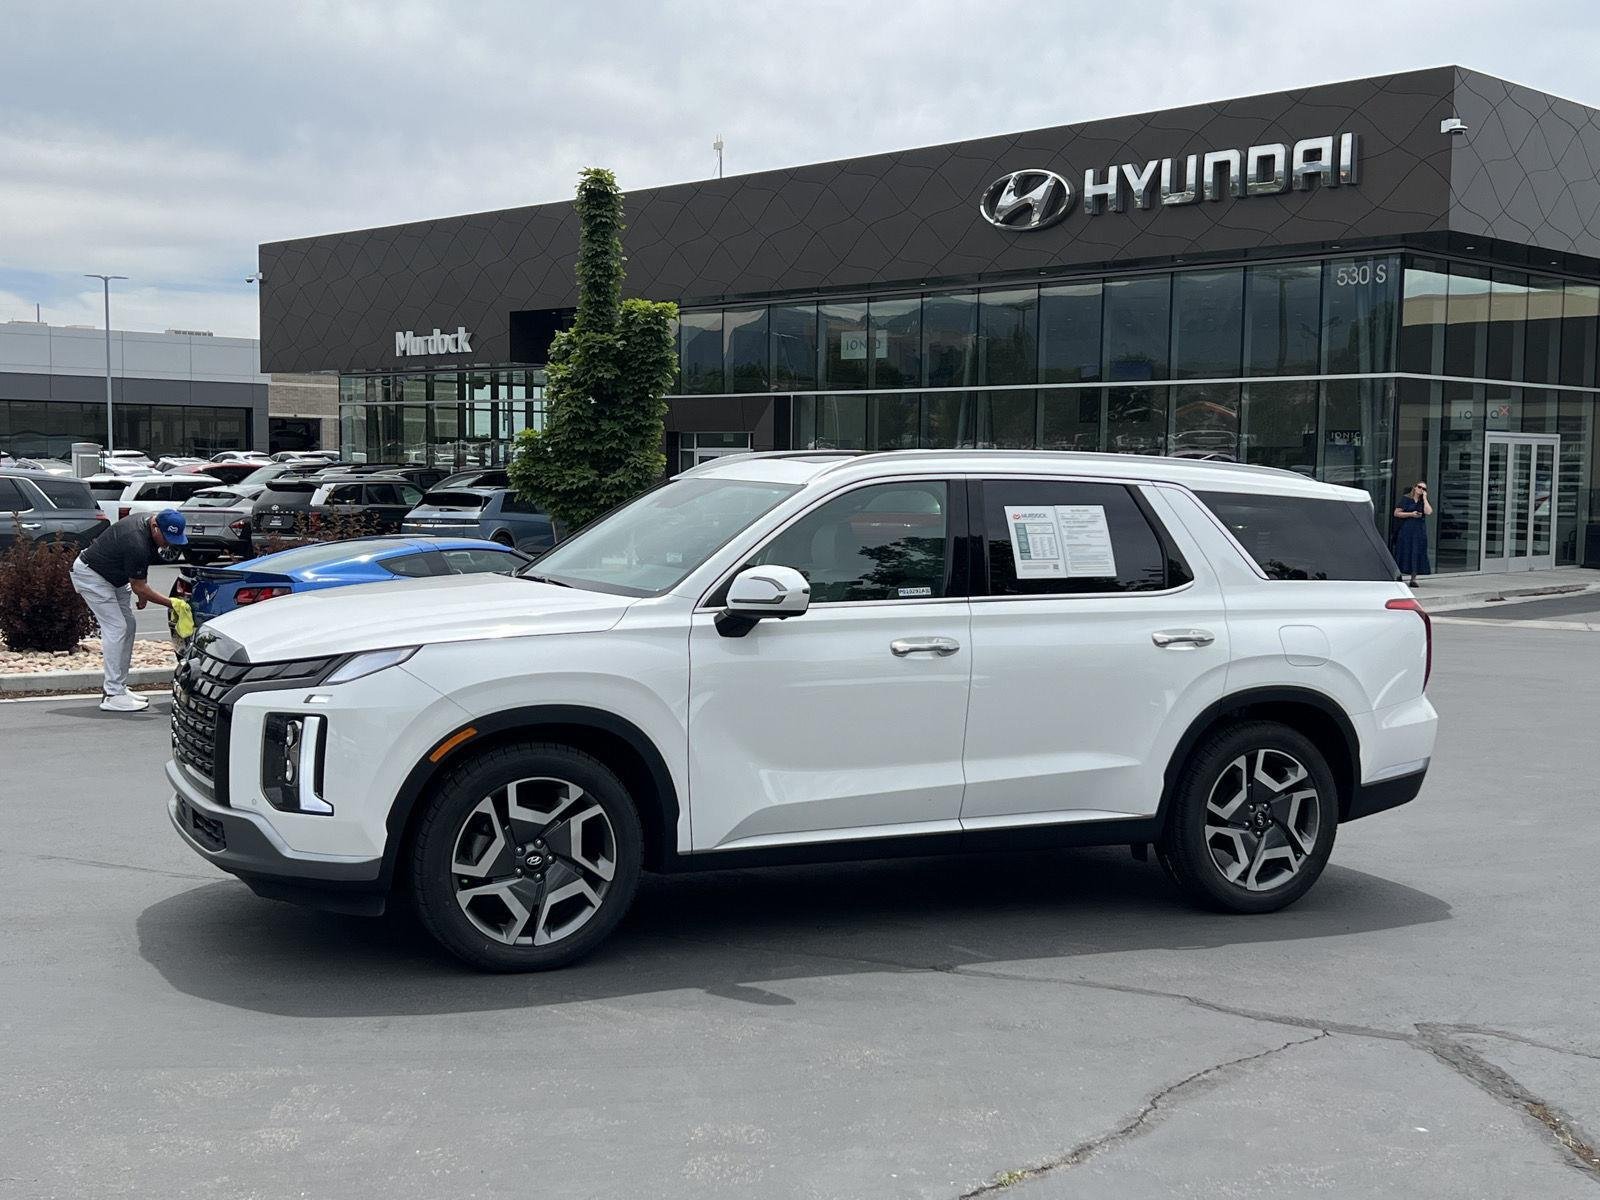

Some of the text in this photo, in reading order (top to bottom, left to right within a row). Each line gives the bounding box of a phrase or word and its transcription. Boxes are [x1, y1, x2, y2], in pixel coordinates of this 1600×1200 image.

[1084, 132, 1357, 215] HYUNDAI
[1336, 264, 1387, 286] 530 S
[395, 326, 473, 357] Murdock
